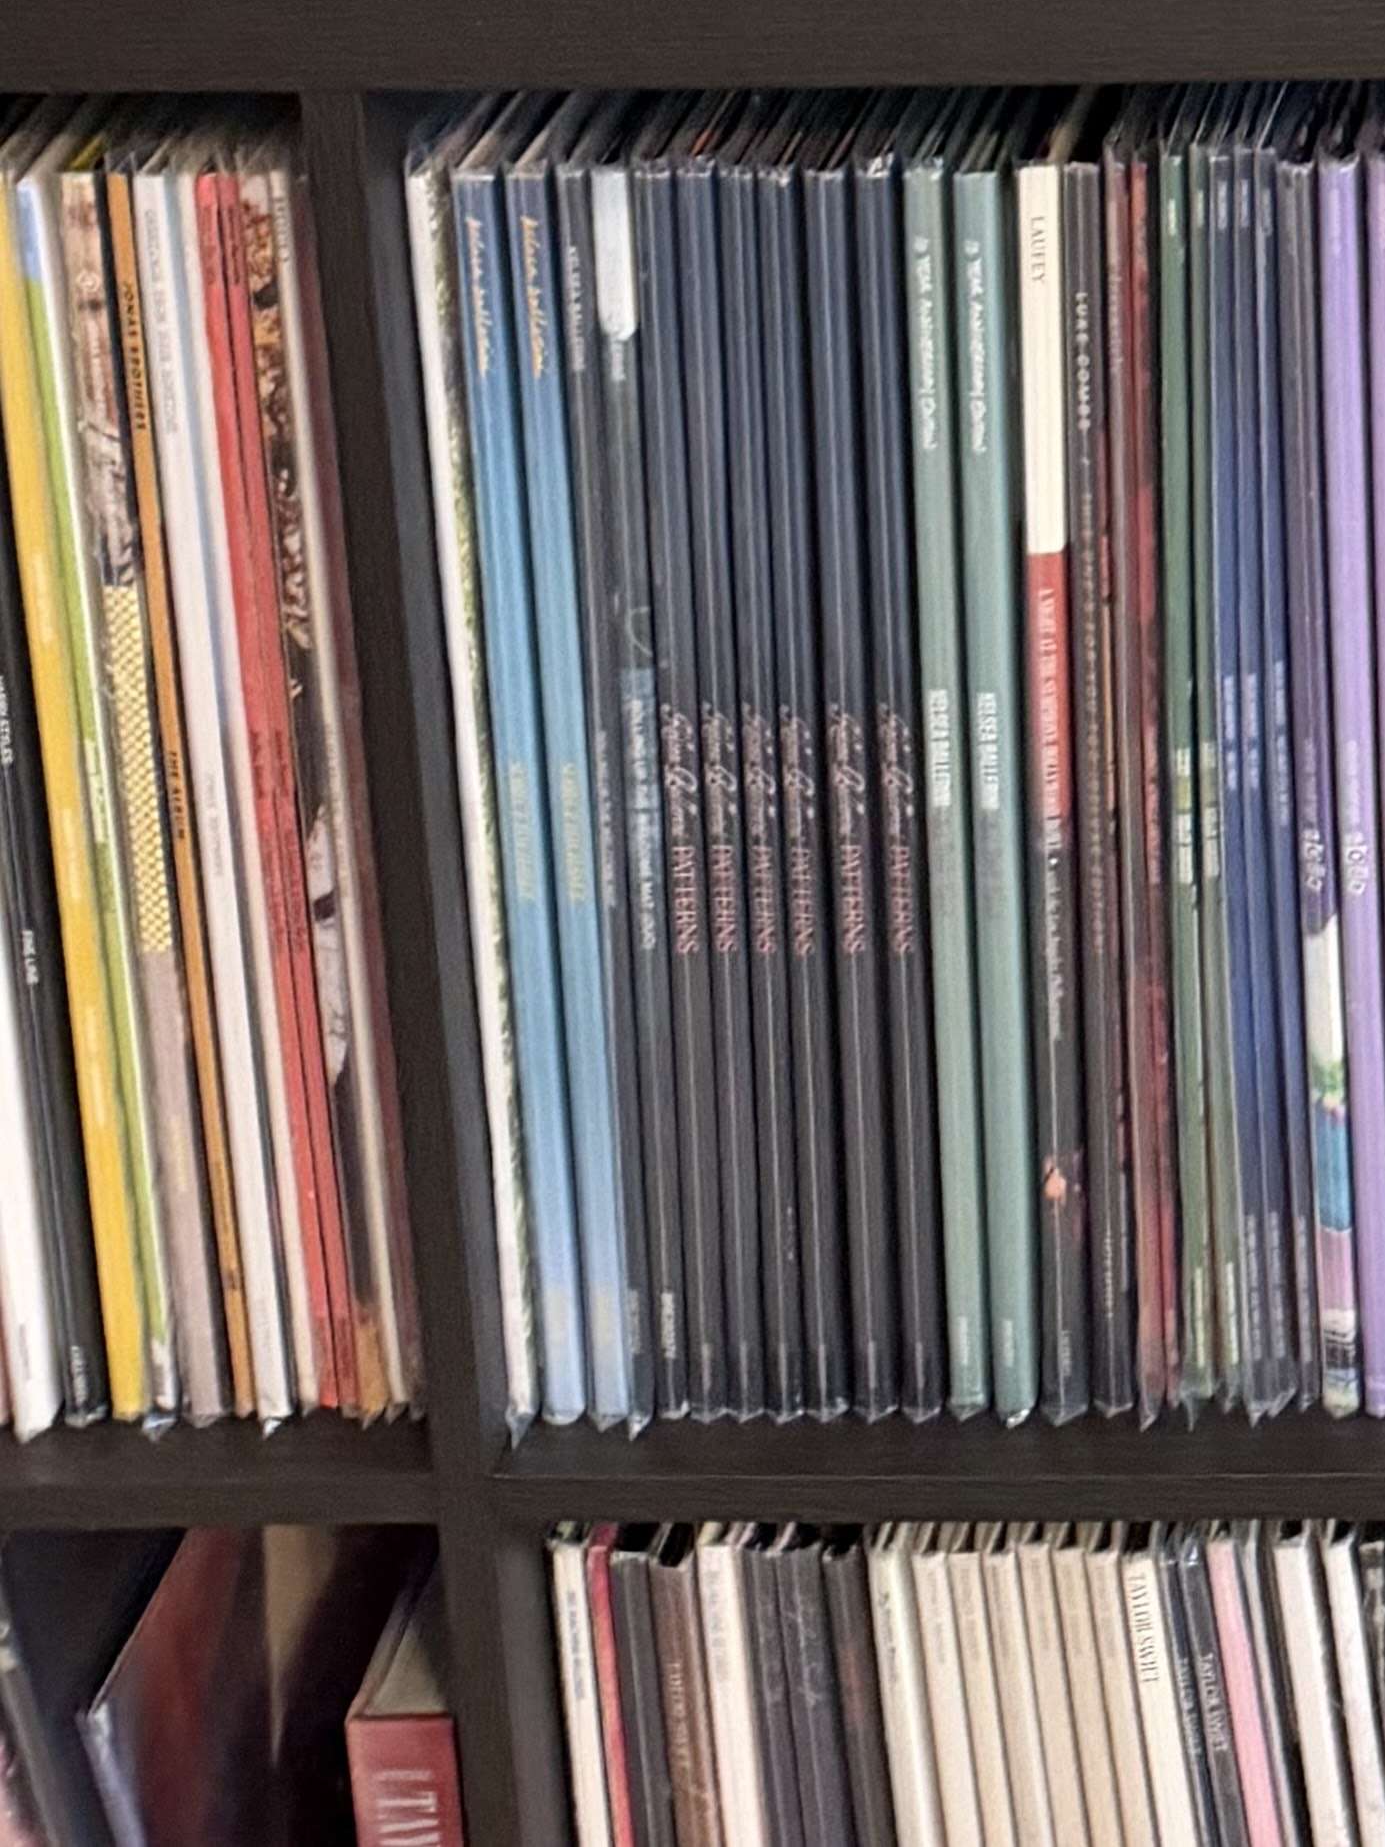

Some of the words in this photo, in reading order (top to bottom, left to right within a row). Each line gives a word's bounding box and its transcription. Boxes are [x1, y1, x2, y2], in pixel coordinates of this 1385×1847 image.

[1029, 215, 1047, 284] LAUFEY
[121, 281, 138, 338] JONAS
[1076, 292, 1090, 343] LUKE
[128, 346, 146, 431] BROTHERS
[1077, 354, 1092, 432] COMBS
[977, 692, 997, 742] KELSEA
[172, 786, 188, 841] ALBUM
[672, 845, 697, 954] PATTERNS
[712, 844, 738, 954] PATTERNS
[753, 845, 776, 955] PATTERNS
[791, 845, 814, 956] PATTERNS
[842, 845, 865, 955] PATTERNS
[890, 845, 913, 955] PATTERNS
[1128, 1573, 1154, 1632] TAYLOR
[1136, 1637, 1160, 1684] SWIFT
[1199, 1653, 1220, 1707] TAYLOR
